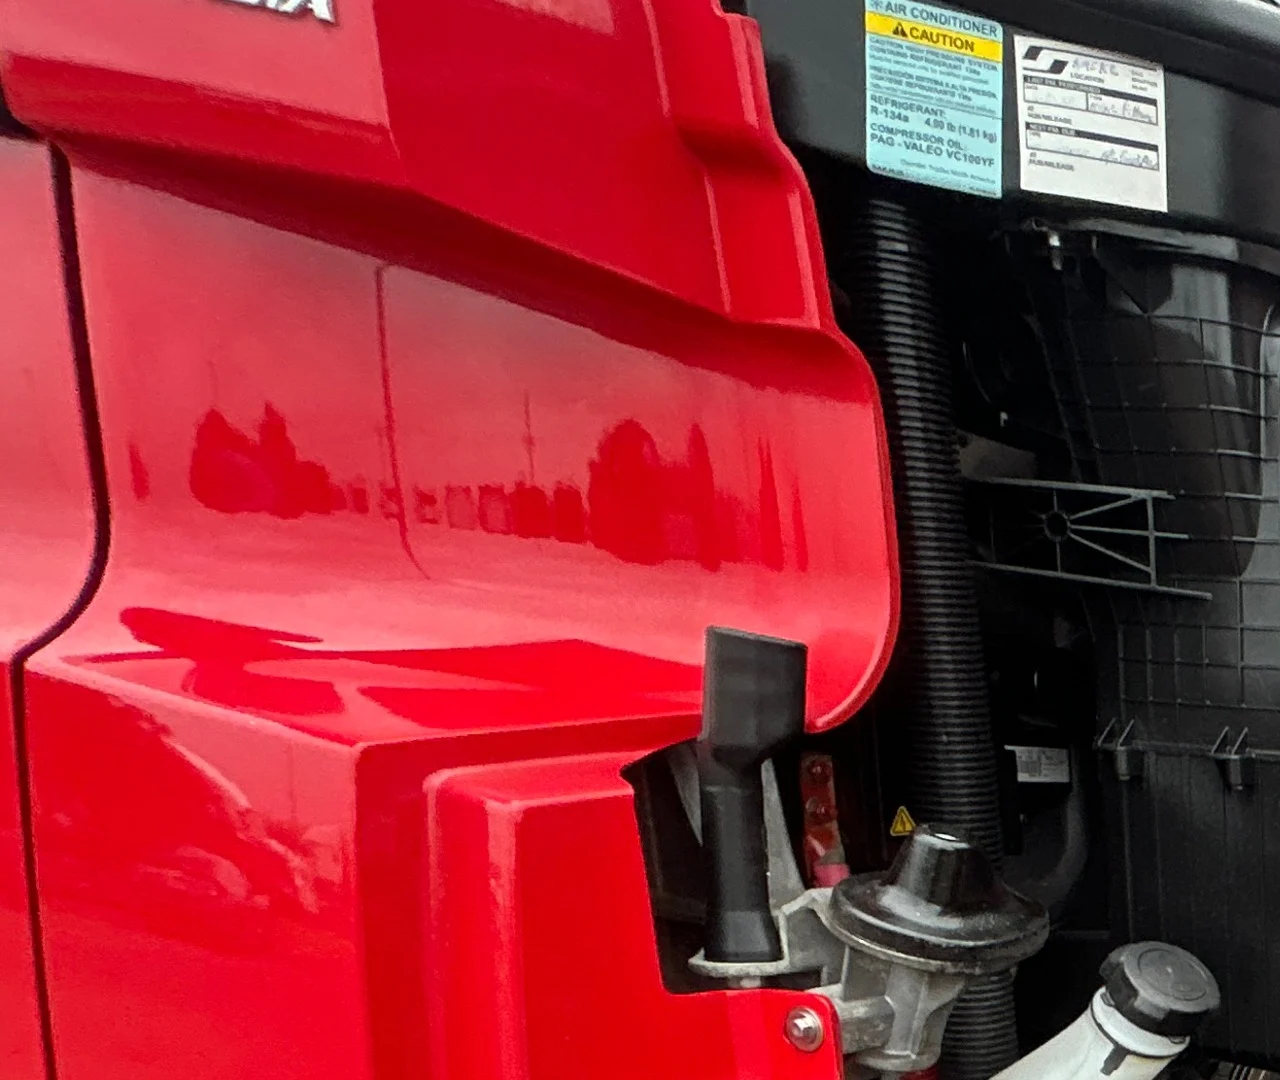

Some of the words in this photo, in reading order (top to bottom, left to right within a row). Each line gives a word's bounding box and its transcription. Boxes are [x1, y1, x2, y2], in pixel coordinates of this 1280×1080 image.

[885, 1, 907, 16] AIR
[911, 7, 997, 37] CONDITIONER
[910, 27, 975, 53] CAUTION
[870, 105, 910, 123] R-134a
[870, 123, 945, 147] COMPRESSOR
[870, 132, 896, 147] PAG
[903, 140, 944, 157] VALEO
